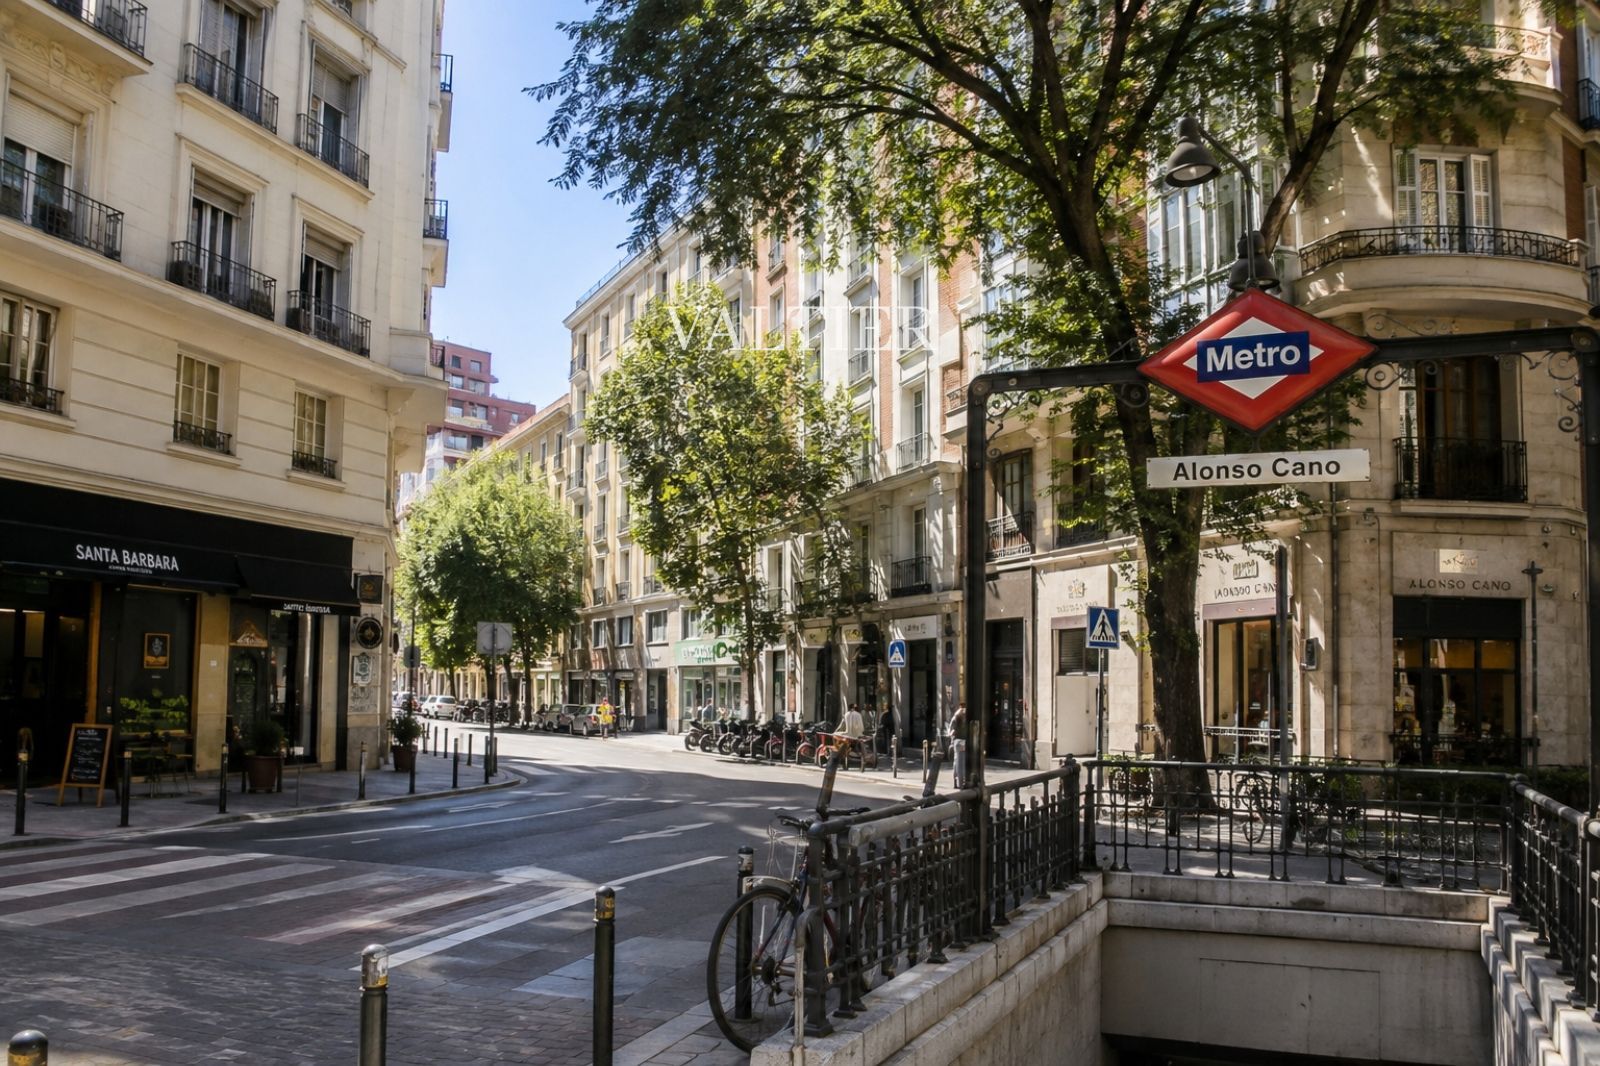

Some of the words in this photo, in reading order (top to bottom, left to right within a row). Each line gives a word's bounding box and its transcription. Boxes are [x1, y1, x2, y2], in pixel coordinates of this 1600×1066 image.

[1206, 342, 1301, 373] Metro
[1173, 462, 1262, 481] Alonso
[1272, 457, 1341, 476] Cano
[75, 544, 120, 564] SANTA
[122, 549, 180, 572] BARBARA
[1409, 578, 1466, 590] ALONSO
[1472, 579, 1512, 591] CANO
